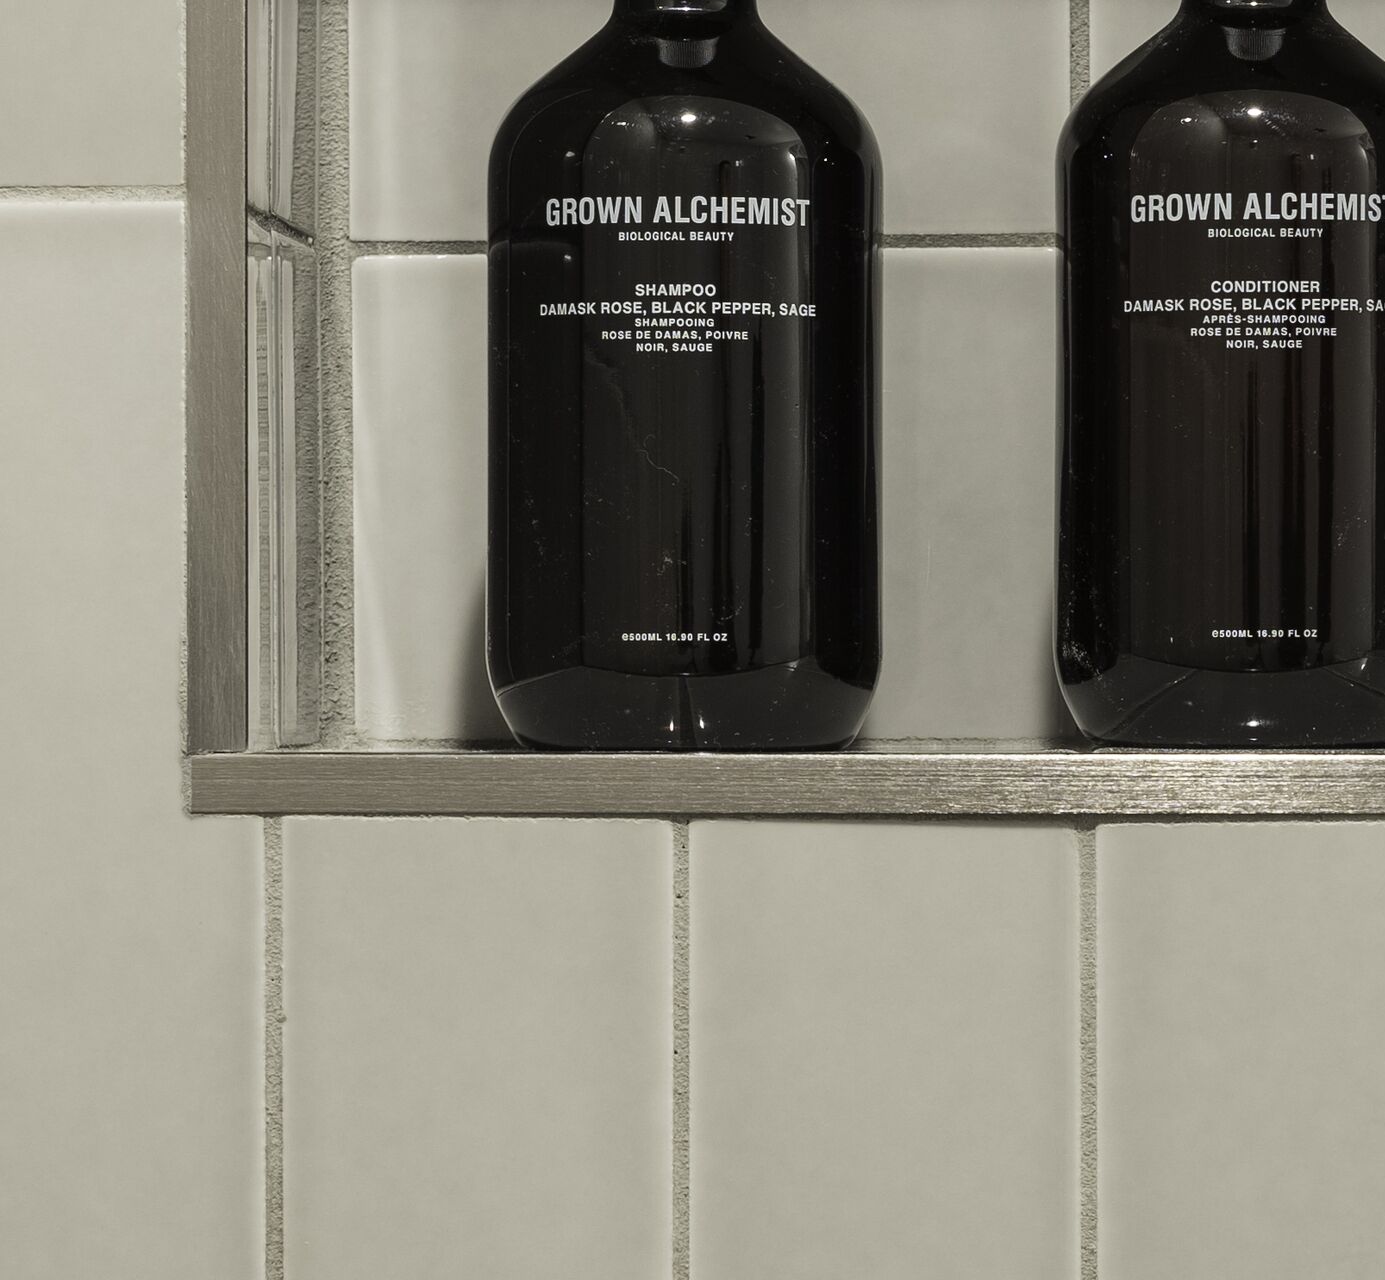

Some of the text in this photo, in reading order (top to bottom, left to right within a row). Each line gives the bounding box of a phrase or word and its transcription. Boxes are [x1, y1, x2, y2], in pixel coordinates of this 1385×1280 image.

[547, 194, 810, 226] GROWN ALCHEMIST
[1131, 193, 1232, 222] GROWN
[619, 231, 734, 241] BIOLOGICAL BEAUTY
[1208, 228, 1323, 237] BIOLOGICAL BEAUTY
[635, 284, 716, 296] SHAMPOO
[1211, 281, 1320, 293] CONDITIONER
[540, 301, 816, 317] DAMASK ROSE, BLACK PEPPER, SAGE
[1124, 299, 1184, 312] DAMASK
[1190, 298, 1236, 314] ROSE,
[1242, 298, 1296, 310] BLACK
[1302, 299, 1362, 313] PEPPER,
[635, 318, 714, 327] SHAMPOOING
[1203, 313, 1325, 323] APRÈS-SHAMPOOING
[602, 331, 748, 340] ROSE DE DAMAS, POIVRE
[1191, 327, 1337, 337] ROSE DE DAMAS, POIVRE
[636, 343, 712, 353] NOIR, SAUGE
[1226, 340, 1302, 349] NOIR, SAUGE
[666, 633, 693, 641] 16.90
[697, 633, 710, 641] FL
[713, 633, 727, 641] OZ
[1304, 629, 1317, 637] OZ
